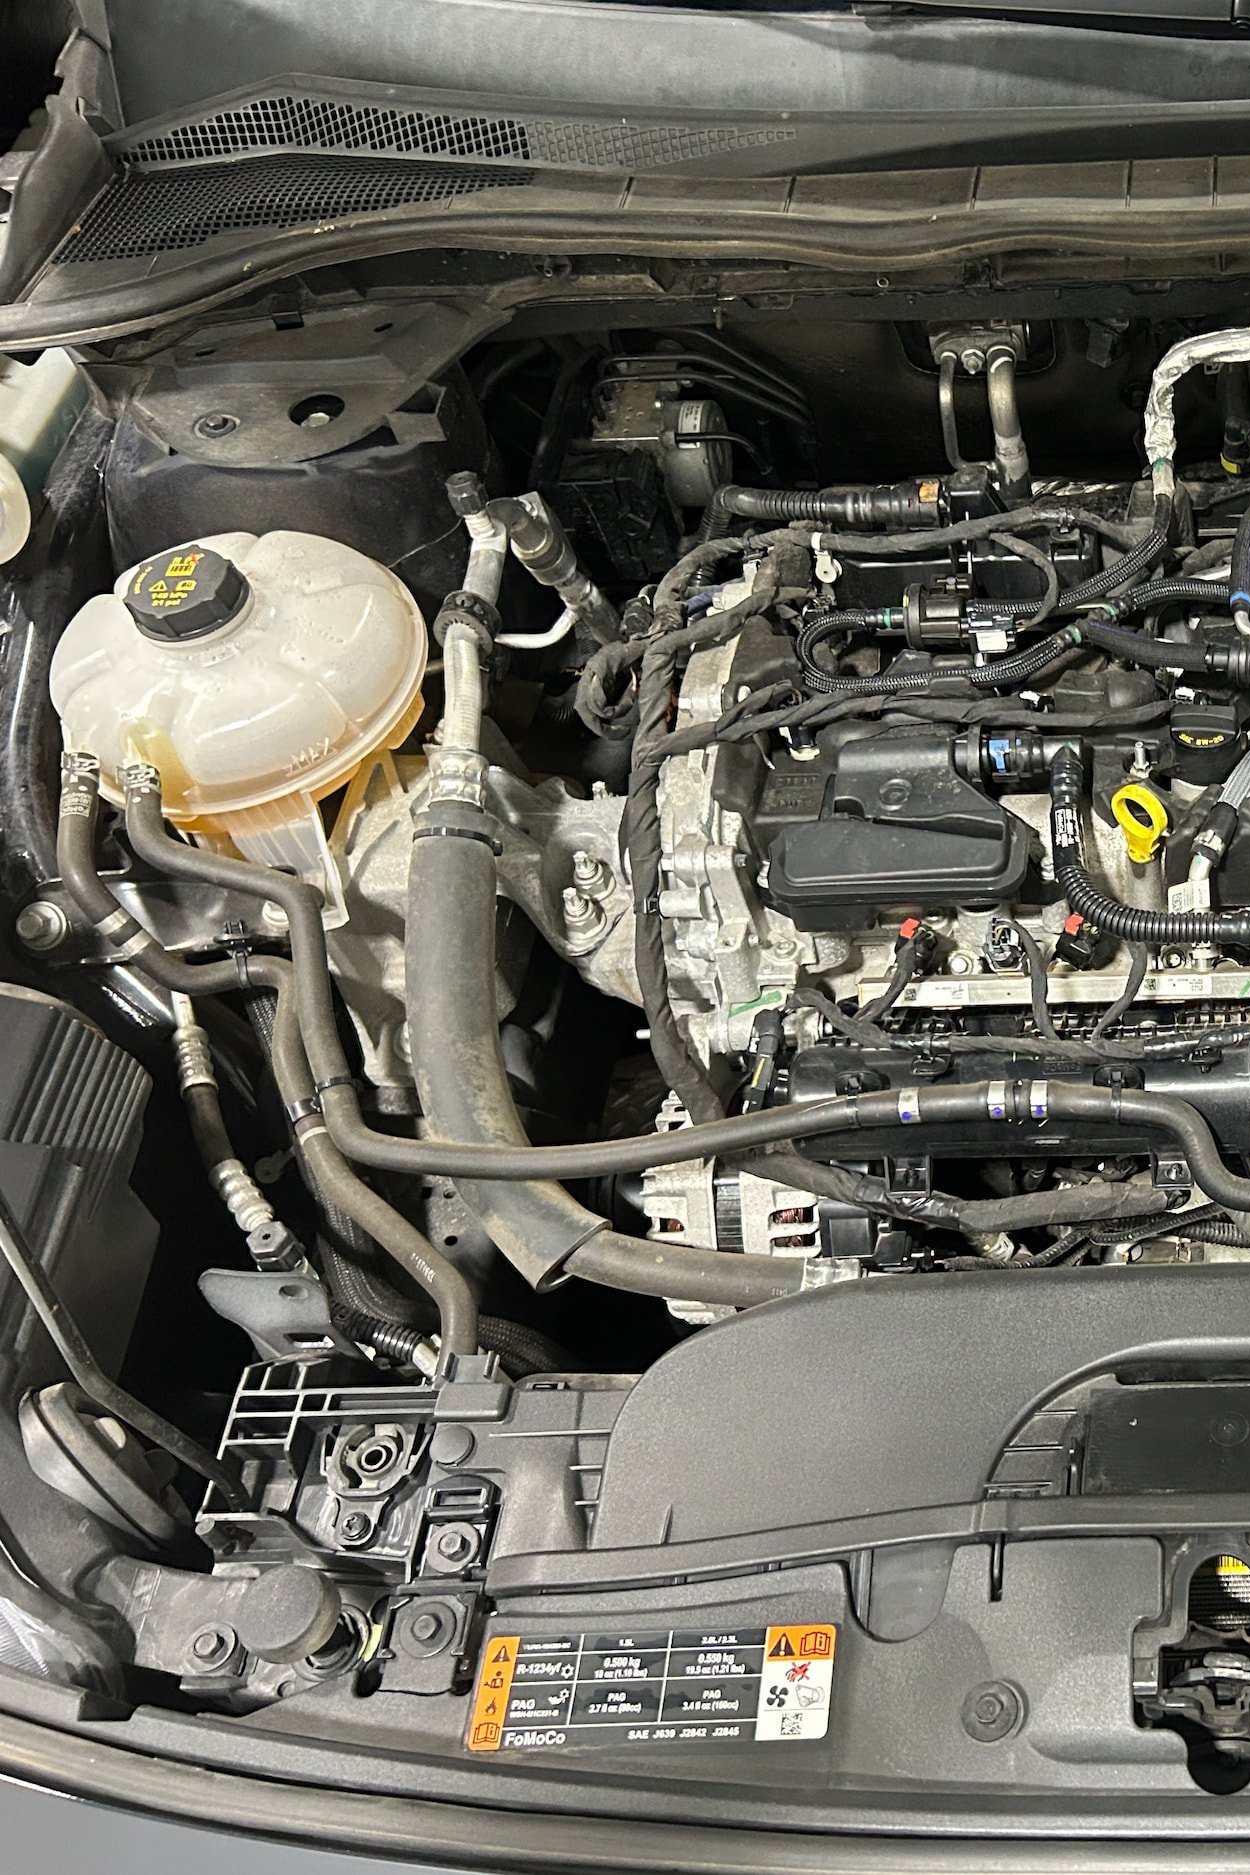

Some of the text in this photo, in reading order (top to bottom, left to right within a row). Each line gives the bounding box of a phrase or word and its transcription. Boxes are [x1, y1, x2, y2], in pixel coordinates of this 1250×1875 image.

[603, 1657, 641, 1669] 0.500 kg
[698, 1652, 735, 1665] 0.550 kg
[516, 1662, 563, 1675] R-1234yf
[607, 1692, 626, 1702] PAG
[702, 1690, 722, 1700] PAG
[511, 1700, 536, 1710] PAG
[504, 1731, 566, 1747] FoMoCo
[628, 1726, 740, 1740] SAE J639 J2842 J2845
